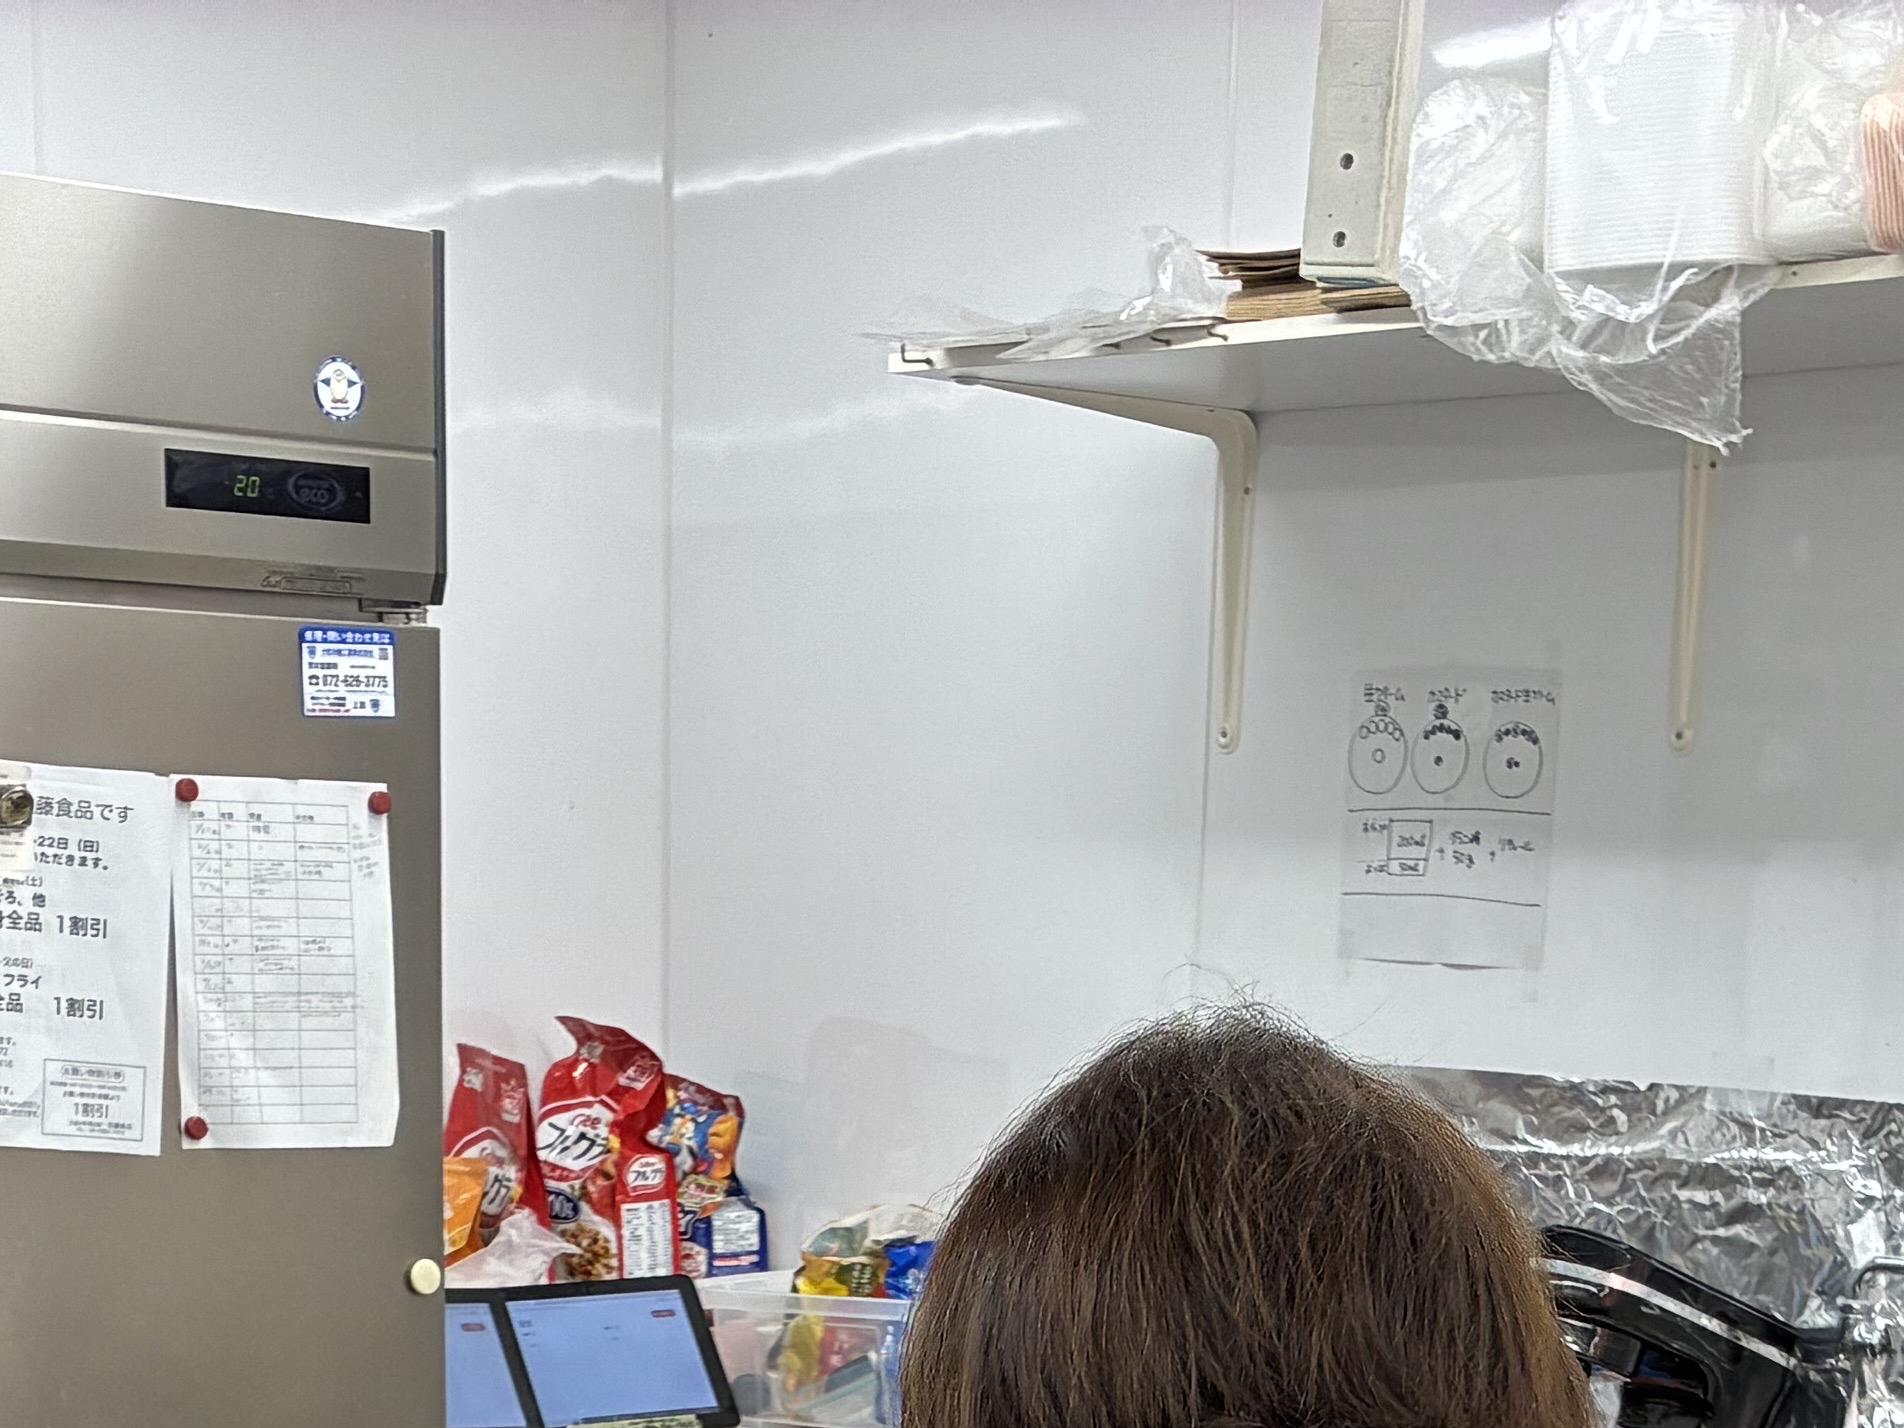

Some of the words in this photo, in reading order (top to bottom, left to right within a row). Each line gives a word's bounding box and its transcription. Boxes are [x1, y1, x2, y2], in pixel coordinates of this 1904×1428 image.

[233, 474, 261, 498] 20
[56, 914, 109, 940] 1割引
[53, 996, 105, 1021] 1割引
